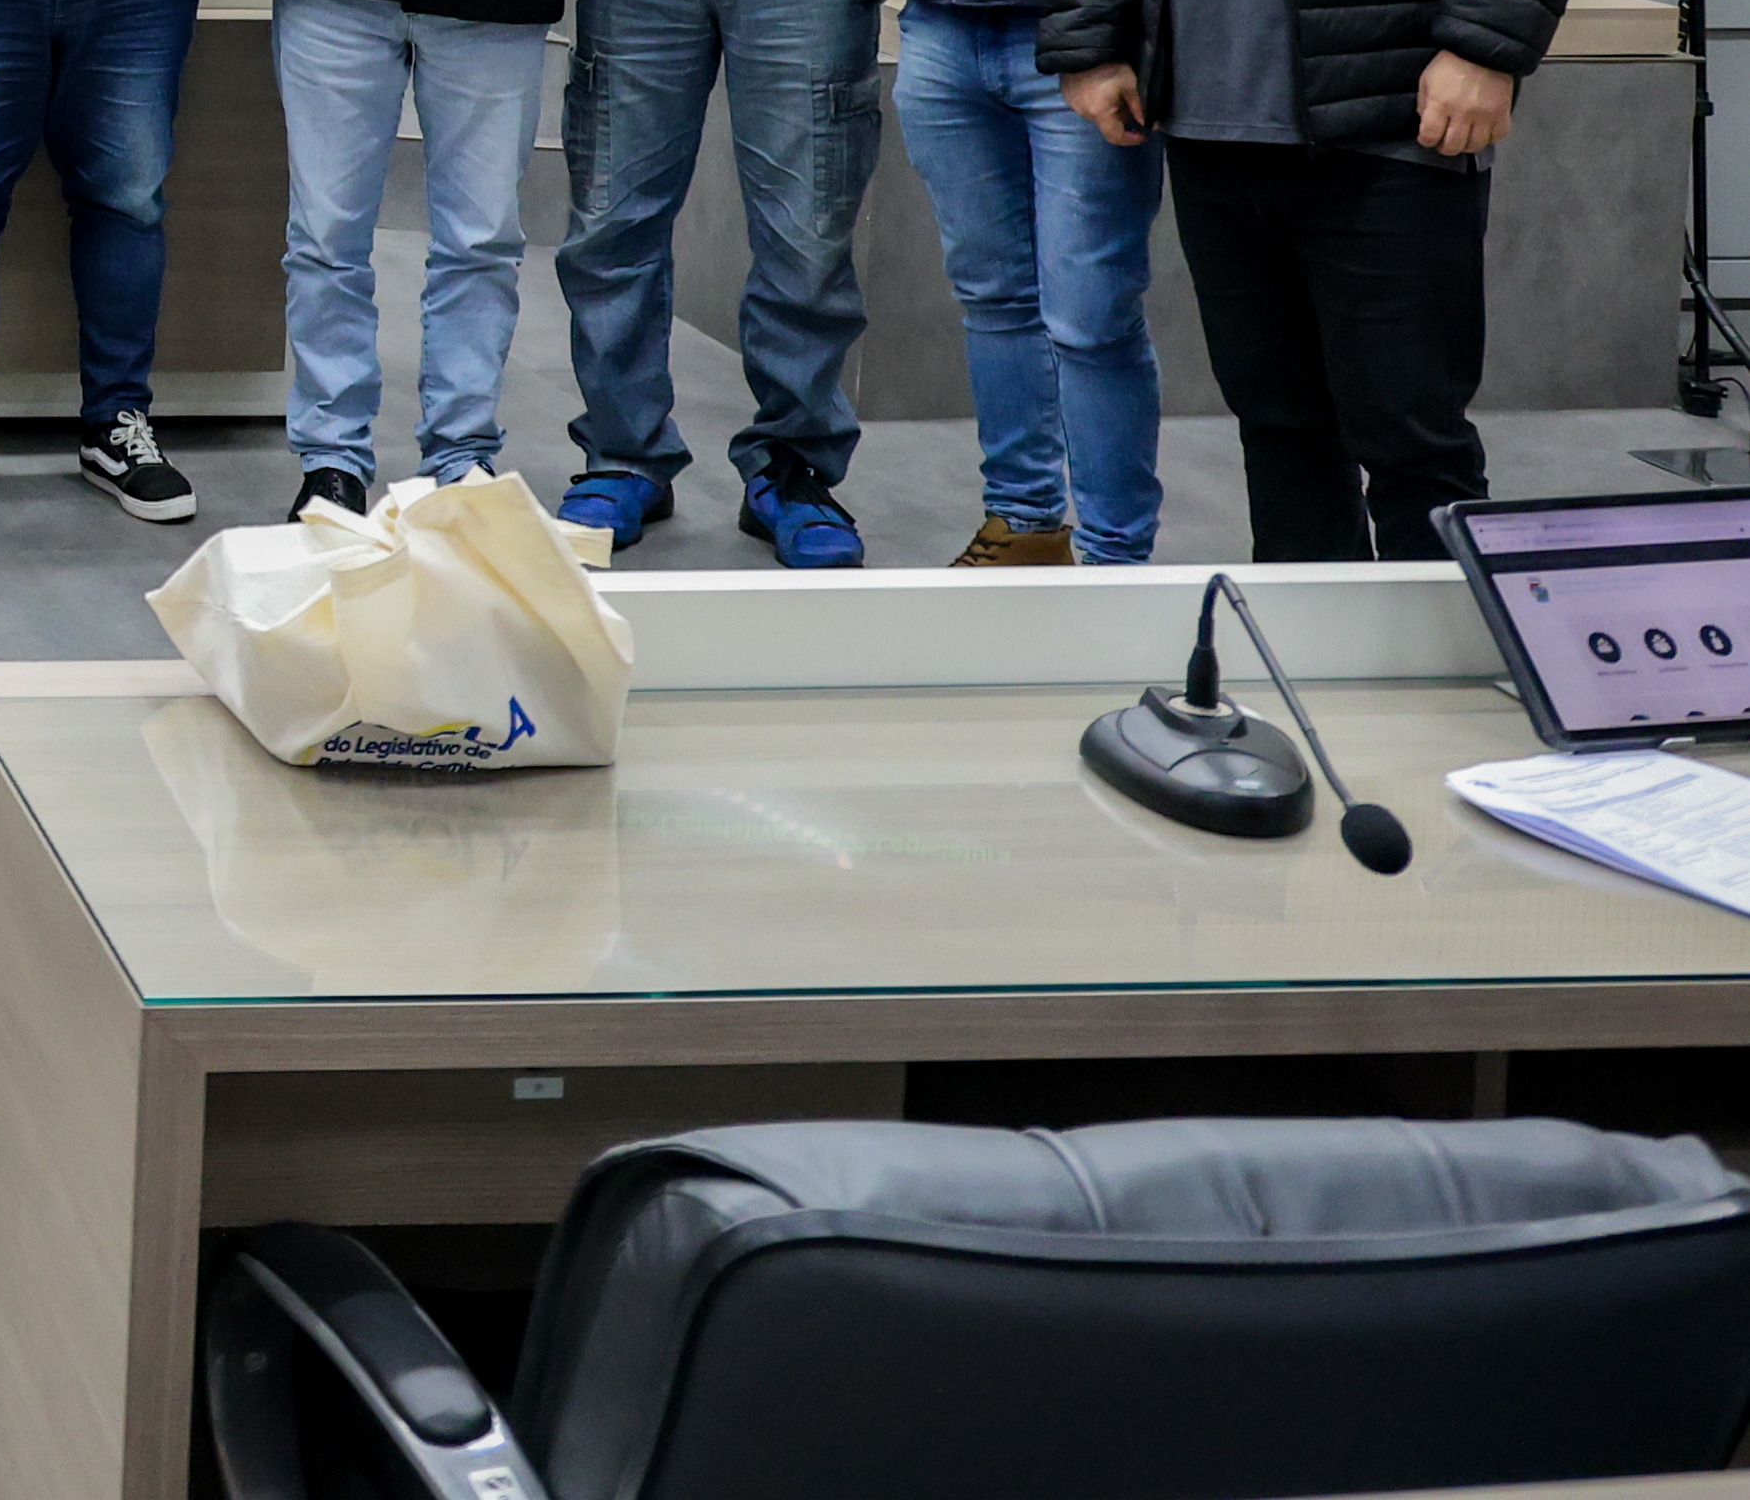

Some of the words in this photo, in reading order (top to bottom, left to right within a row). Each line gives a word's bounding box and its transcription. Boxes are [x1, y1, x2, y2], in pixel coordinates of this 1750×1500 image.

[324, 739, 350, 753] do
[355, 737, 461, 759] Legislativo
[465, 746, 492, 760] de
